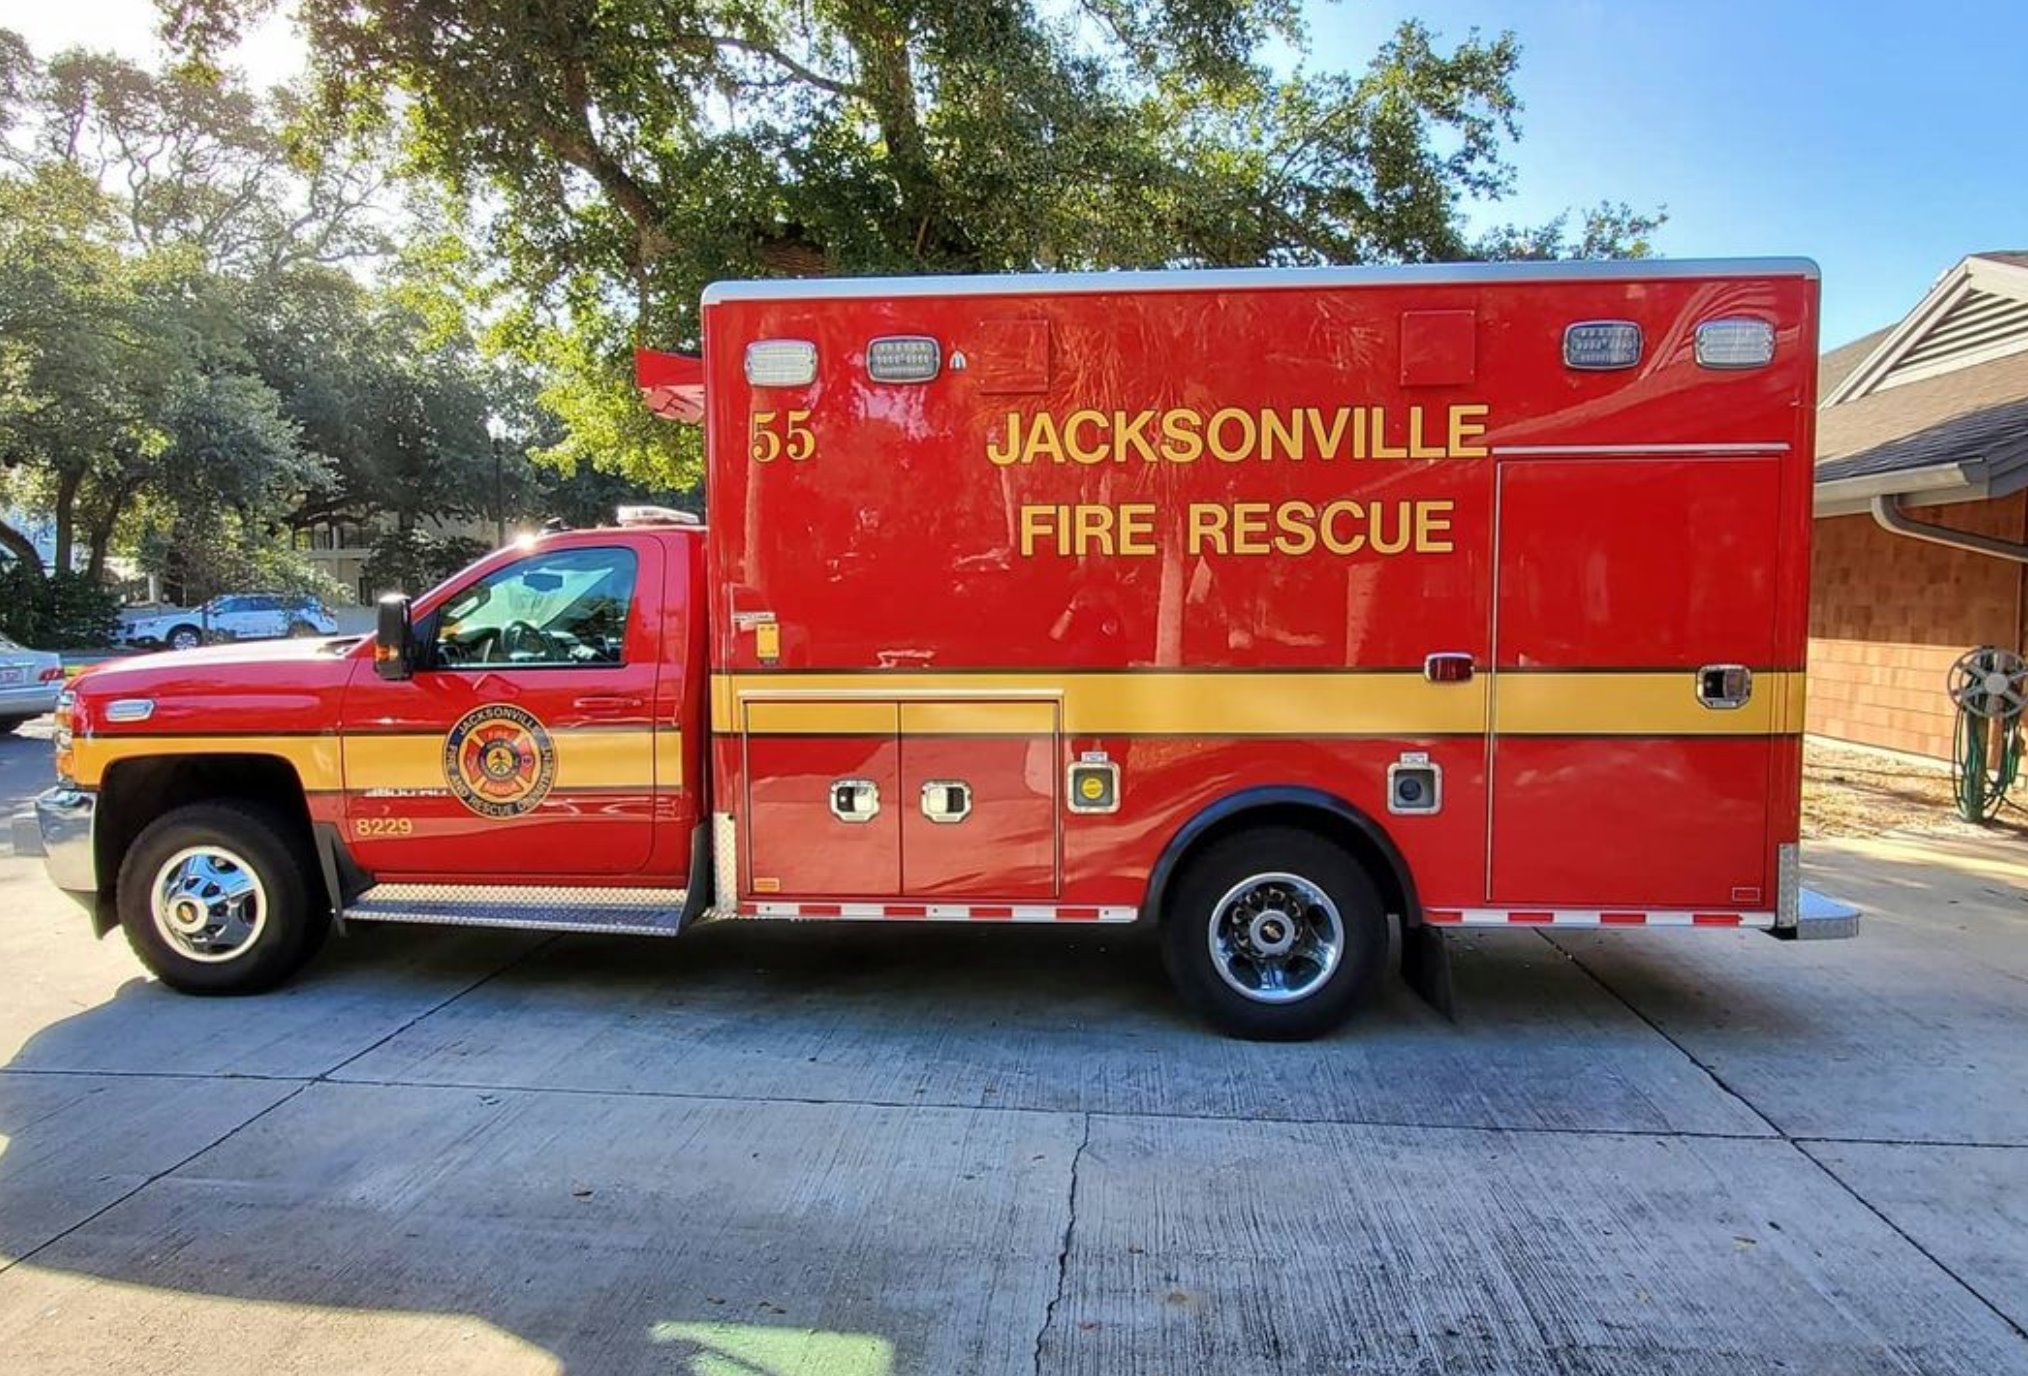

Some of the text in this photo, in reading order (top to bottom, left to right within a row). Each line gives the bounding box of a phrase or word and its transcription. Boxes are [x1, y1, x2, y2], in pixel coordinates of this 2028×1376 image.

[751, 410, 816, 463] 55
[986, 404, 1489, 467] JACKSONVILLE
[1020, 500, 1455, 556] FIRE RESCUE
[458, 706, 544, 737] JACKSONVILLE
[356, 816, 413, 836] 8229
[468, 796, 514, 817] RESCUE
